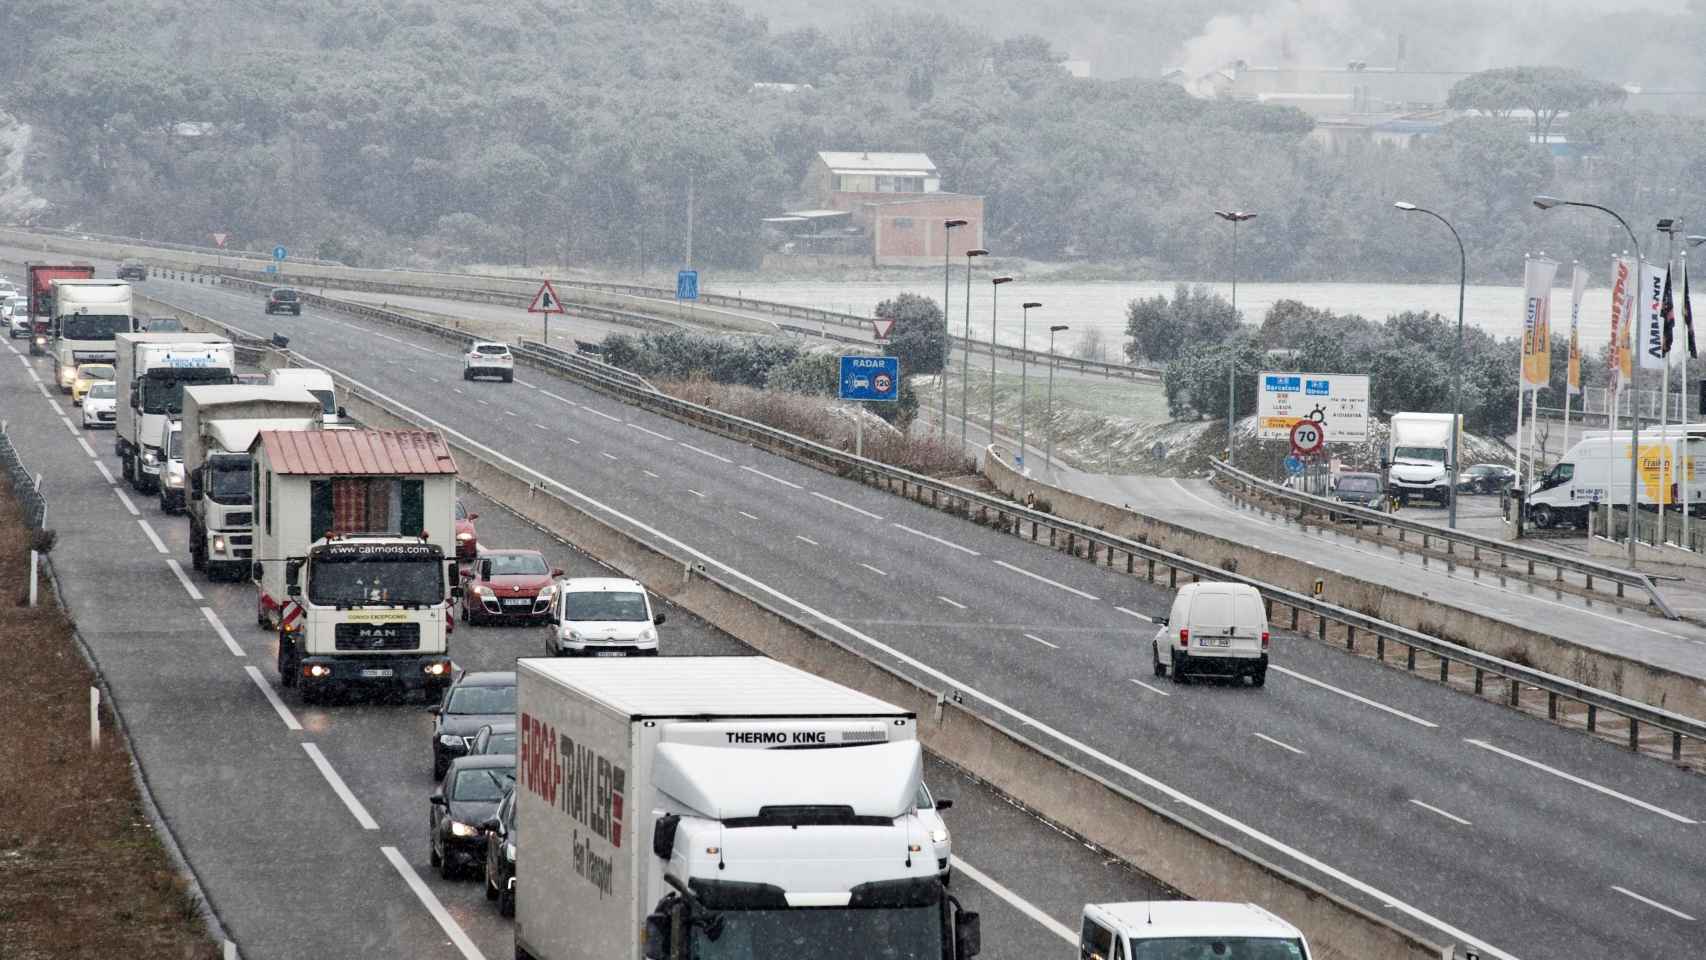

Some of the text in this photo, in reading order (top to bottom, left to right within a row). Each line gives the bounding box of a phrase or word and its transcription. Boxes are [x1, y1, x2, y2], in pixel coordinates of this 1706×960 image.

[852, 359, 886, 368] RADAR
[1299, 431, 1316, 442] 70
[359, 546, 430, 554] catmods.com
[360, 629, 396, 637] MAN
[726, 732, 826, 743] THERMO KING
